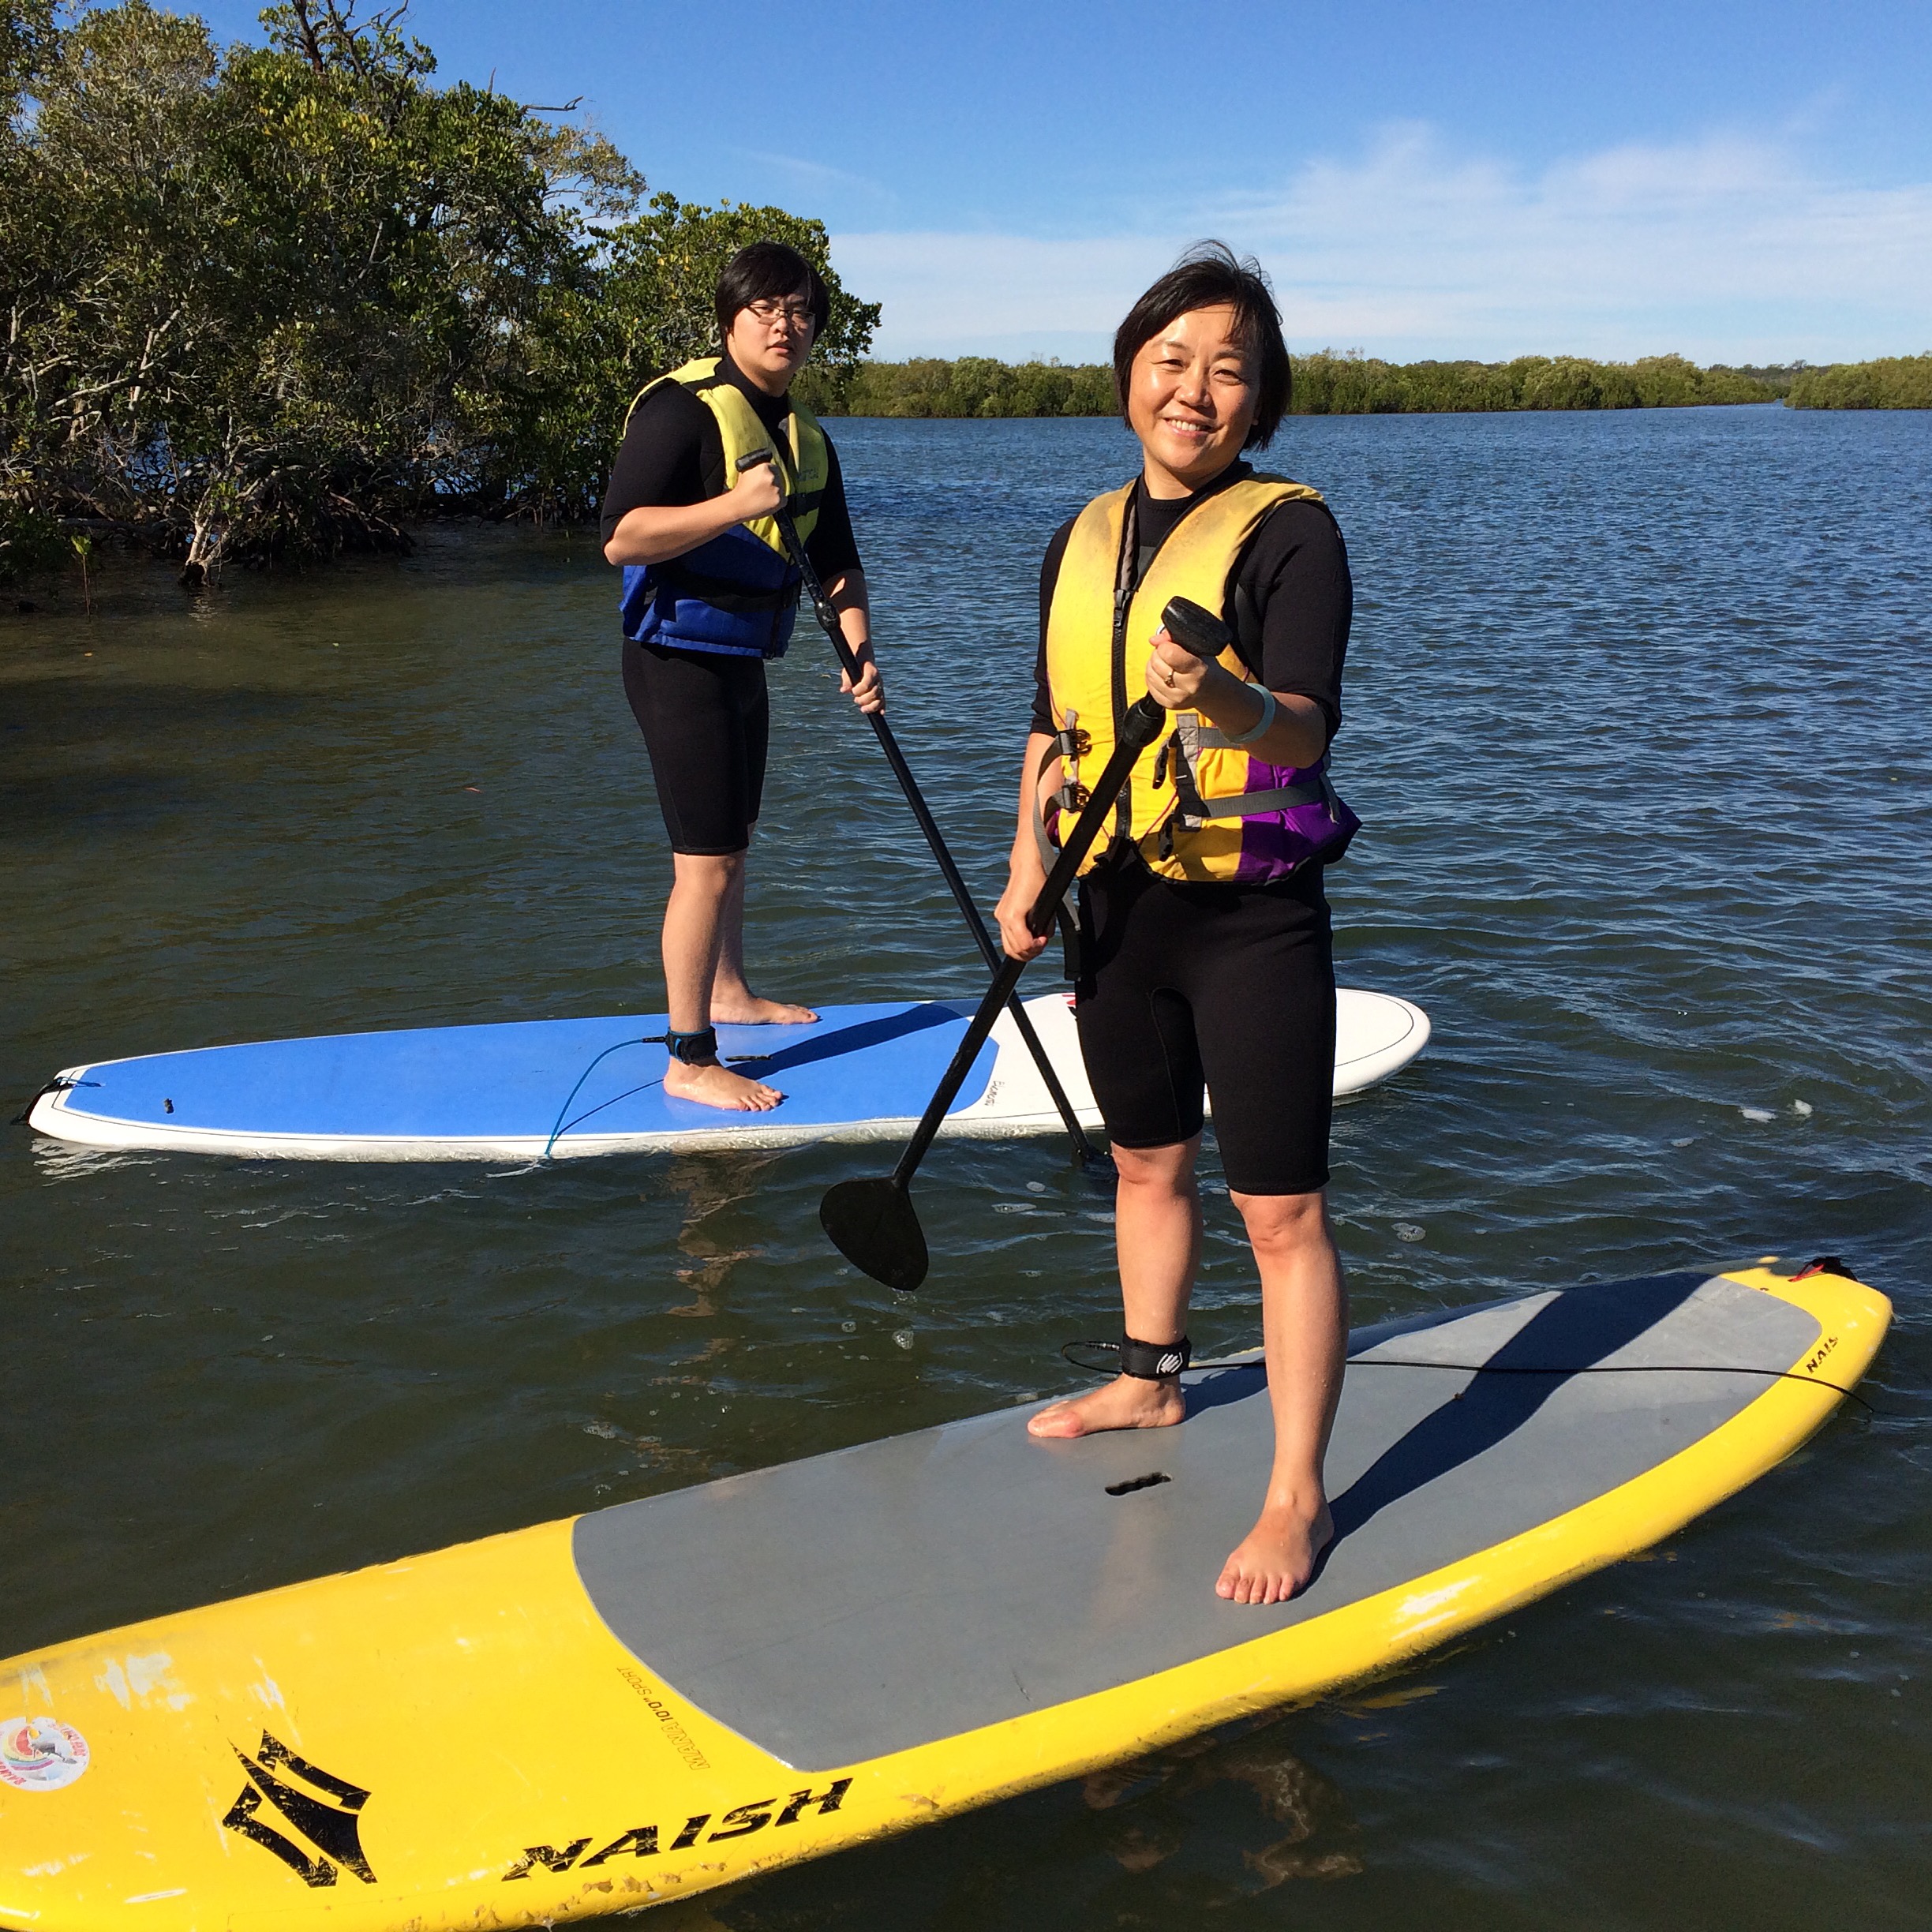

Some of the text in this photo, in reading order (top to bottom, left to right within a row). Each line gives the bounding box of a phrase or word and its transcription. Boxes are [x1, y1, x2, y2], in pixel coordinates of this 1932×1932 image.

[616, 1667, 653, 1696] SPORT
[661, 1721, 710, 1770] MANA
[502, 1777, 853, 1881] NAISH
